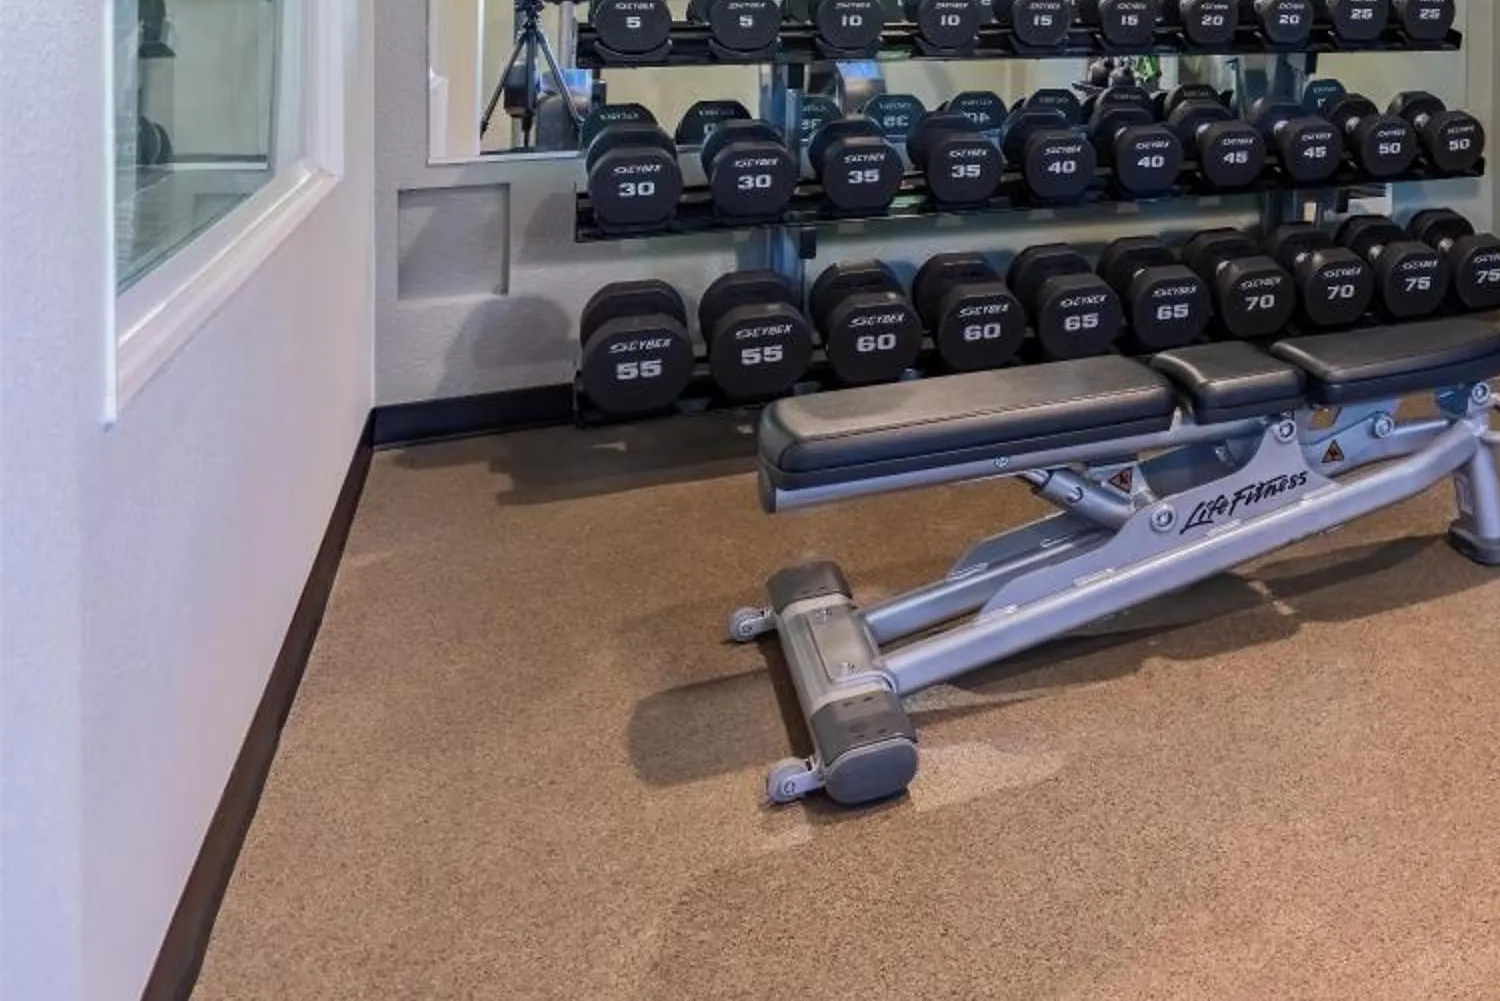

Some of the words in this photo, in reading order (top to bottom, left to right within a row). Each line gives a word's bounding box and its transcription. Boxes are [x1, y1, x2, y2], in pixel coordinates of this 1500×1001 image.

[739, 15, 753, 27] 5
[842, 14, 863, 26] 10
[940, 14, 961, 26] 10
[1033, 15, 1053, 26] 15
[1121, 15, 1138, 26] 15
[1201, 15, 1224, 26] 20
[1278, 14, 1300, 25] 20
[1350, 8, 1373, 20] 25
[1419, 8, 1441, 20] 25
[626, 16, 641, 28] 5
[1379, 142, 1401, 155] 50
[1449, 138, 1470, 151] 50
[1223, 151, 1248, 164] 45
[1303, 146, 1327, 159] 45
[1048, 160, 1077, 174] 40
[1137, 155, 1165, 168] 40
[848, 168, 880, 184] 35
[951, 164, 981, 178] 35
[737, 174, 773, 190] 30
[618, 182, 656, 197] 30
[1475, 268, 1500, 284] 75
[1404, 276, 1431, 292] 75
[1327, 284, 1356, 300] 70
[1244, 294, 1275, 311] 70
[1156, 303, 1189, 321] 65
[1063, 312, 1099, 332] 65
[963, 322, 1001, 341] 60
[856, 333, 897, 353] 60
[741, 344, 784, 366] 55
[616, 360, 663, 380] 55
[1180, 494, 1230, 535] Life
[1228, 471, 1309, 516] Fitness
